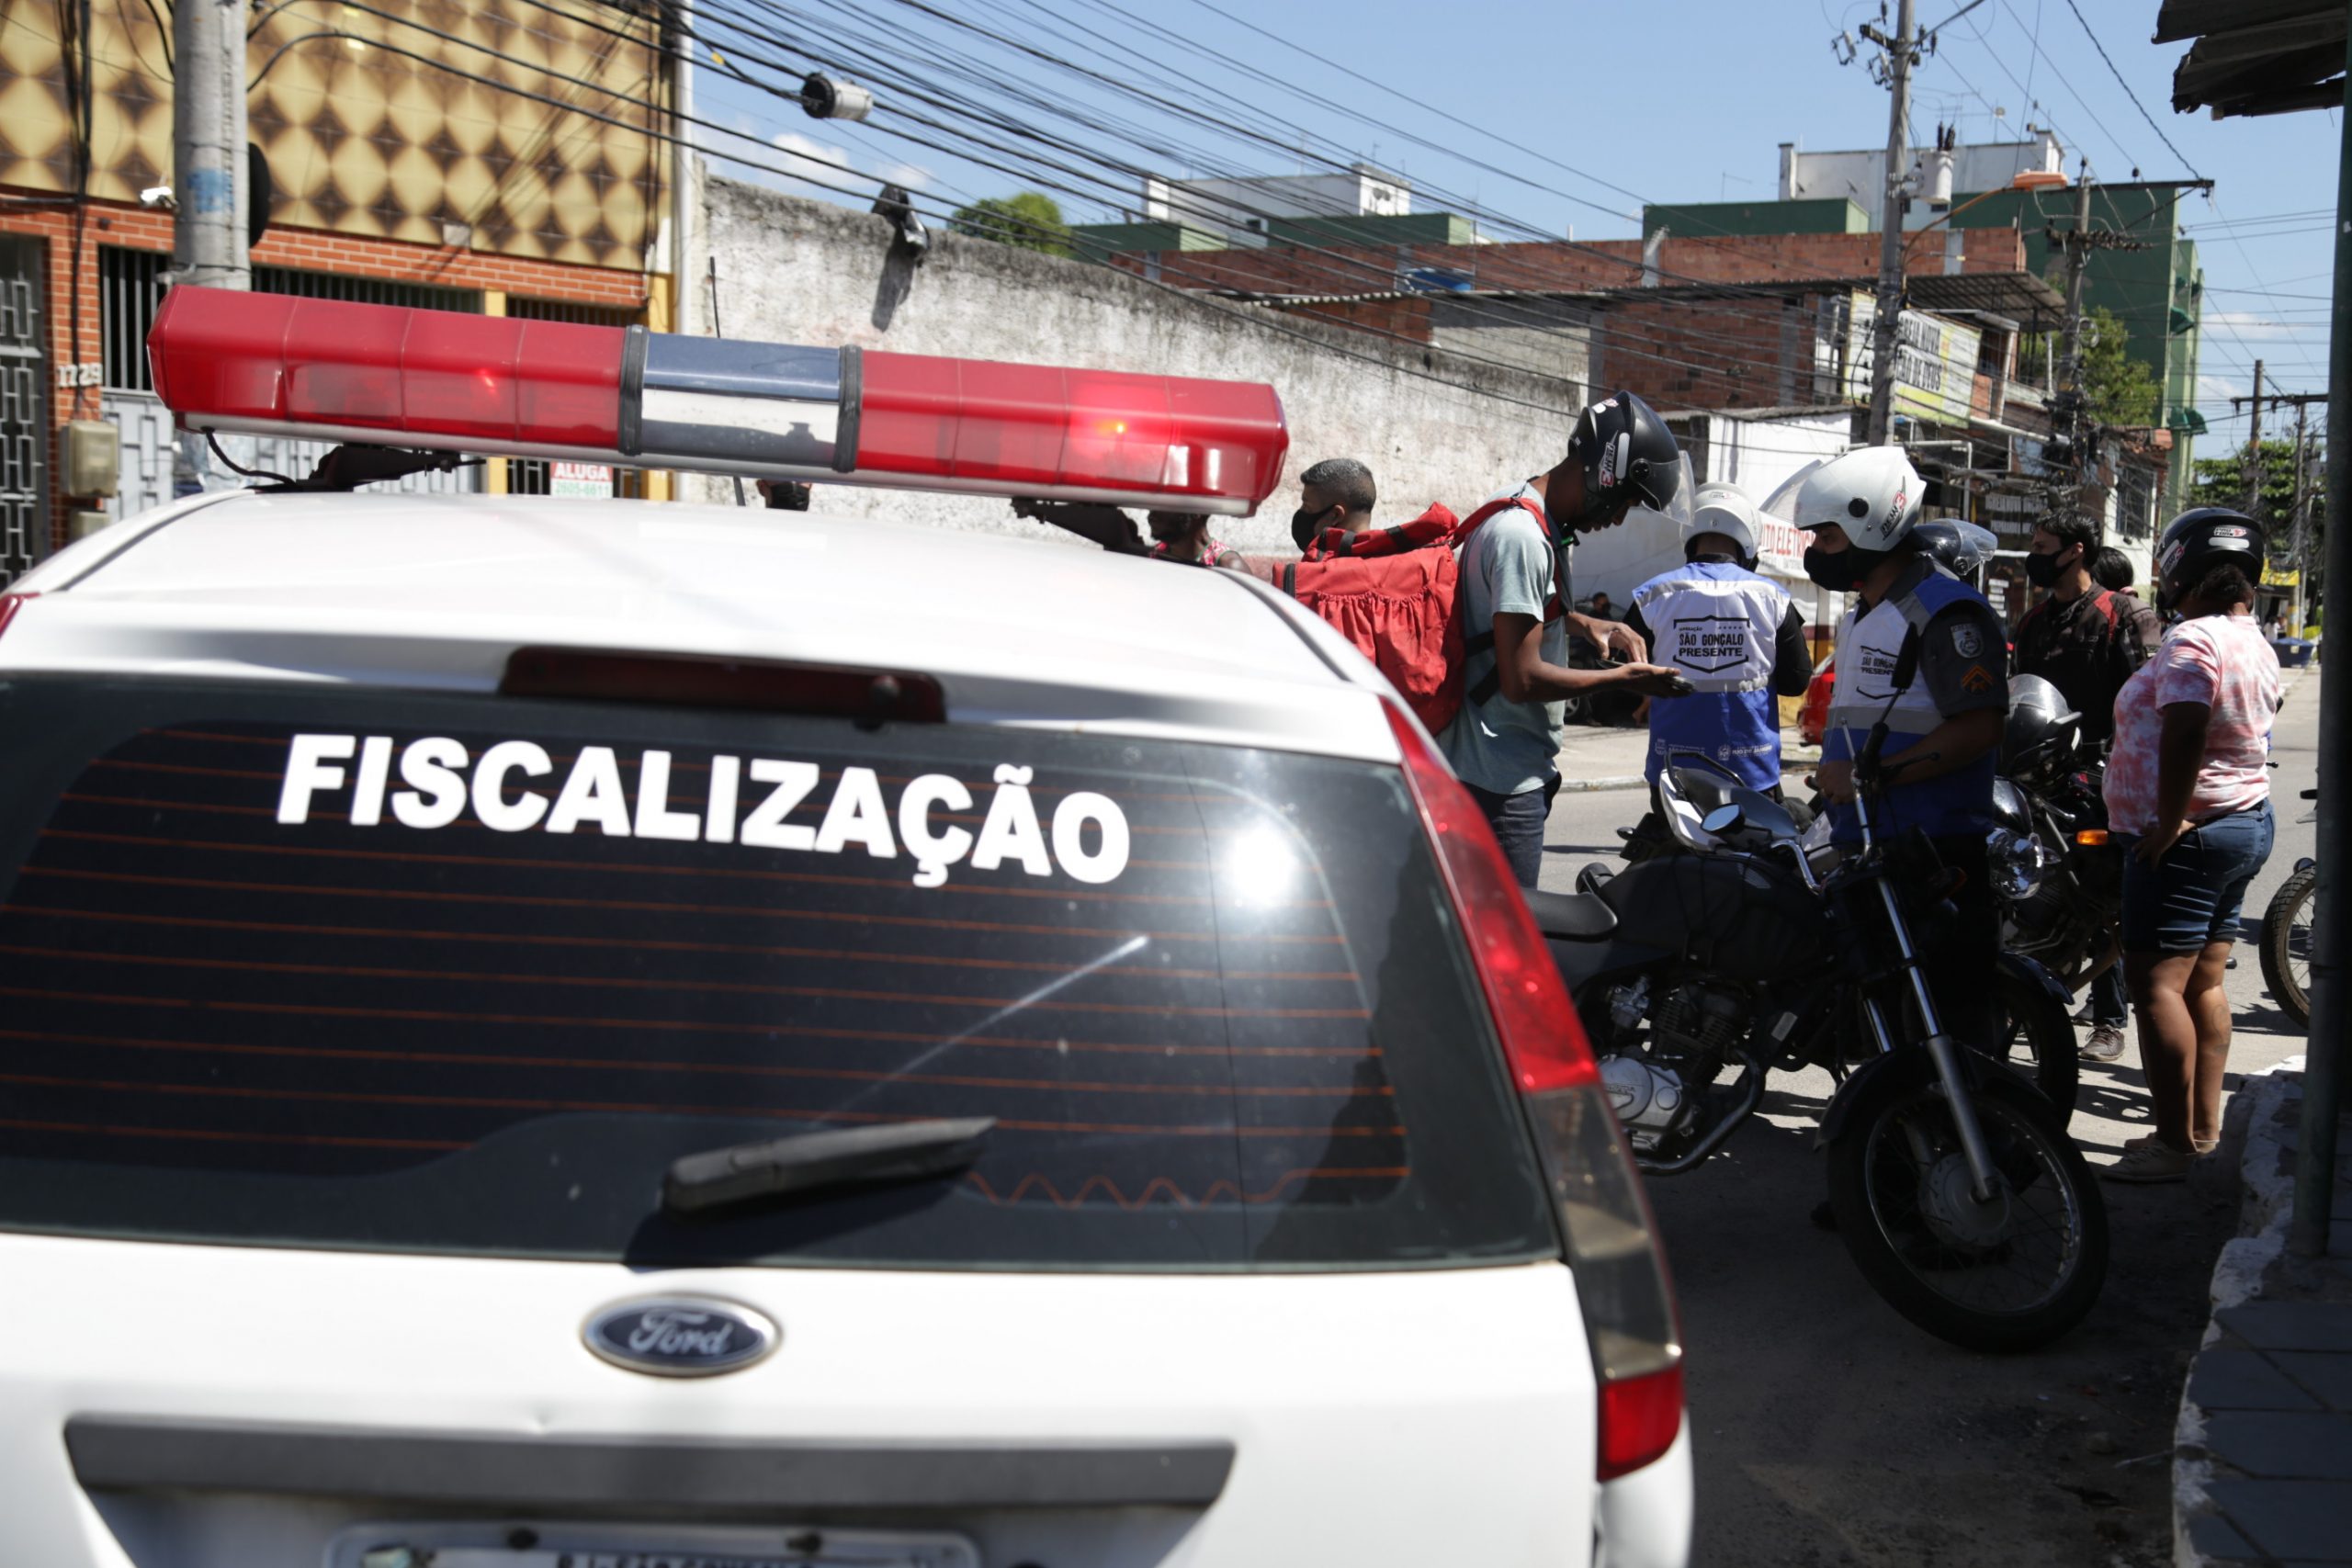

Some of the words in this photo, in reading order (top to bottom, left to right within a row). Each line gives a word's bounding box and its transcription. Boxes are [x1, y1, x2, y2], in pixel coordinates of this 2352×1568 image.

[58, 363, 103, 387] 1729
[554, 463, 609, 479] ALUGA
[1679, 632, 1697, 646] SÃO
[1702, 633, 1744, 647] GONÇALO
[1679, 648, 1743, 658] PRESENTE
[278, 734, 1131, 888] FISCALIZAÇÃO
[628, 1308, 735, 1356] Ford
